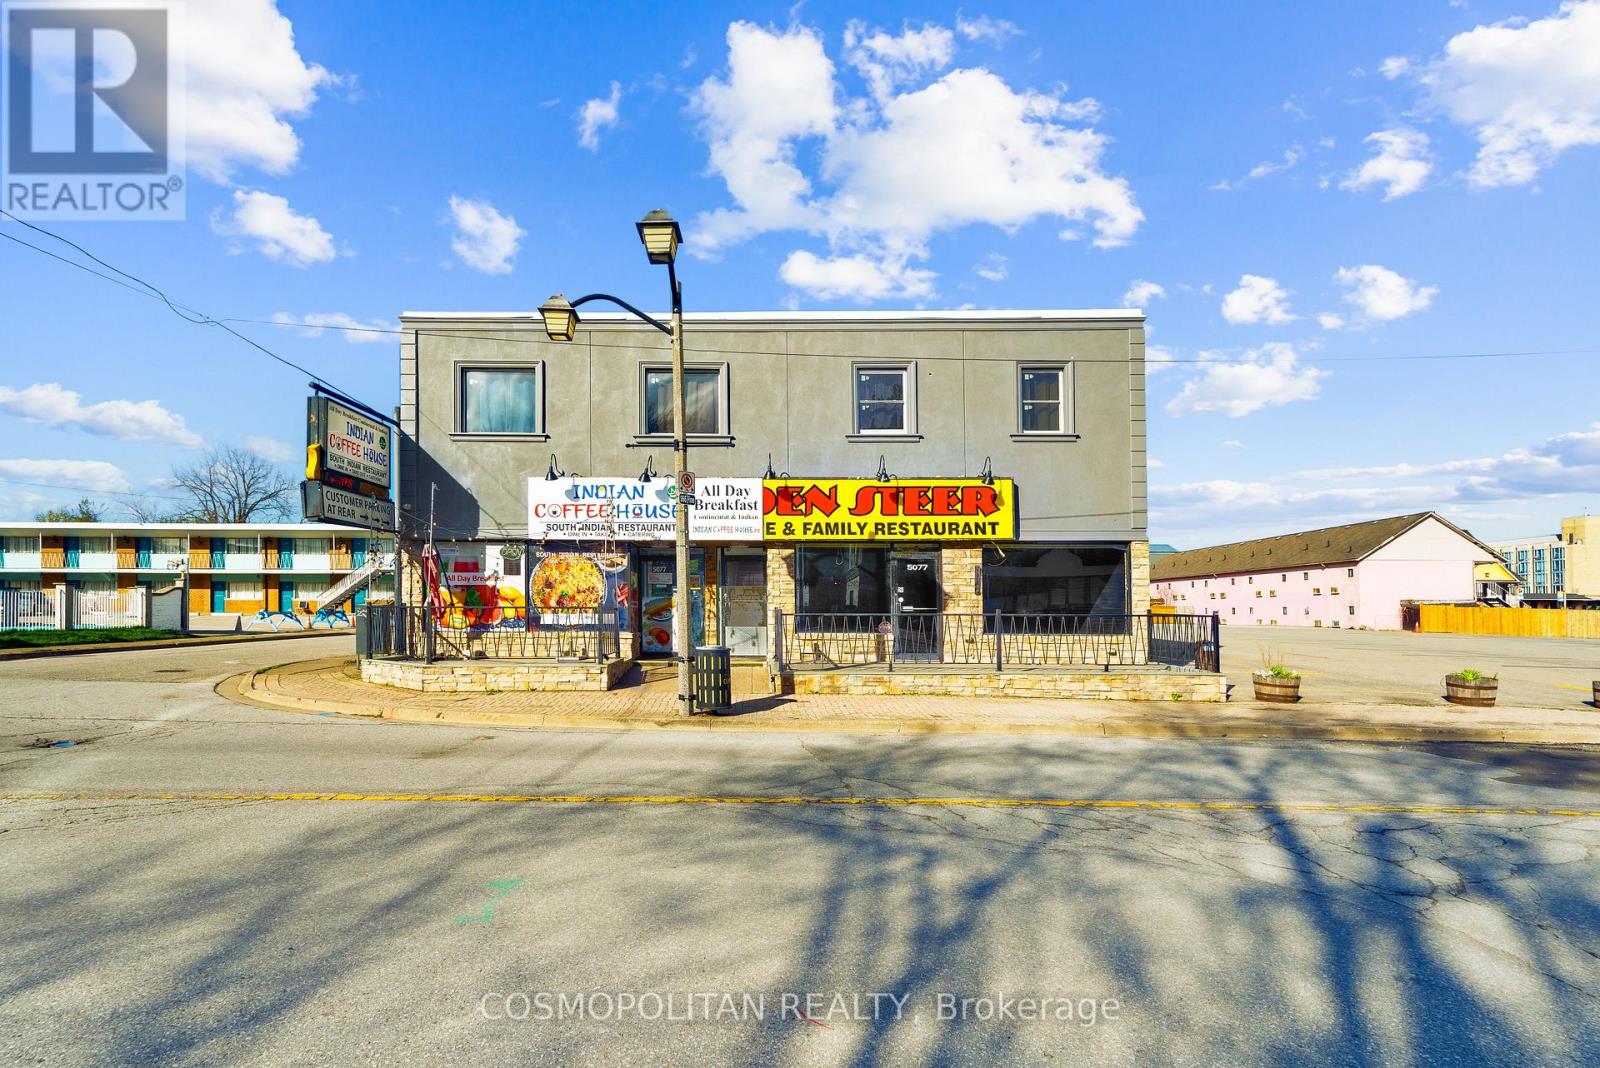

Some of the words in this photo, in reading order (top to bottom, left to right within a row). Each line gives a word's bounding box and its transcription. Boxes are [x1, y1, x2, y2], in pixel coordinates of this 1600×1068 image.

[346, 421, 375, 445] INDIAN
[329, 433, 361, 458] COFFEE
[363, 447, 388, 467] HOUSE
[329, 453, 345, 465] SOUTH
[346, 459, 362, 471] INDIAN
[362, 464, 387, 479] RESTAURANT
[325, 490, 364, 509] CUSTOMER
[572, 484, 645, 500] INDIAN
[701, 484, 720, 497] All
[725, 484, 751, 500] Day
[694, 498, 758, 511] Breakfast
[847, 485, 1001, 518] STEER
[327, 503, 336, 515] AT
[337, 505, 356, 519] REAR
[534, 503, 611, 519] COFFEE
[546, 523, 577, 532] SOUTH
[618, 523, 677, 532] RESTAURANT
[765, 521, 777, 536] E
[782, 521, 796, 536] &
[802, 521, 868, 536] FAMILY
[874, 521, 1000, 536] RESTAURANT
[906, 563, 929, 571] 5077
[447, 574, 456, 582] All
[457, 574, 471, 583] Day
